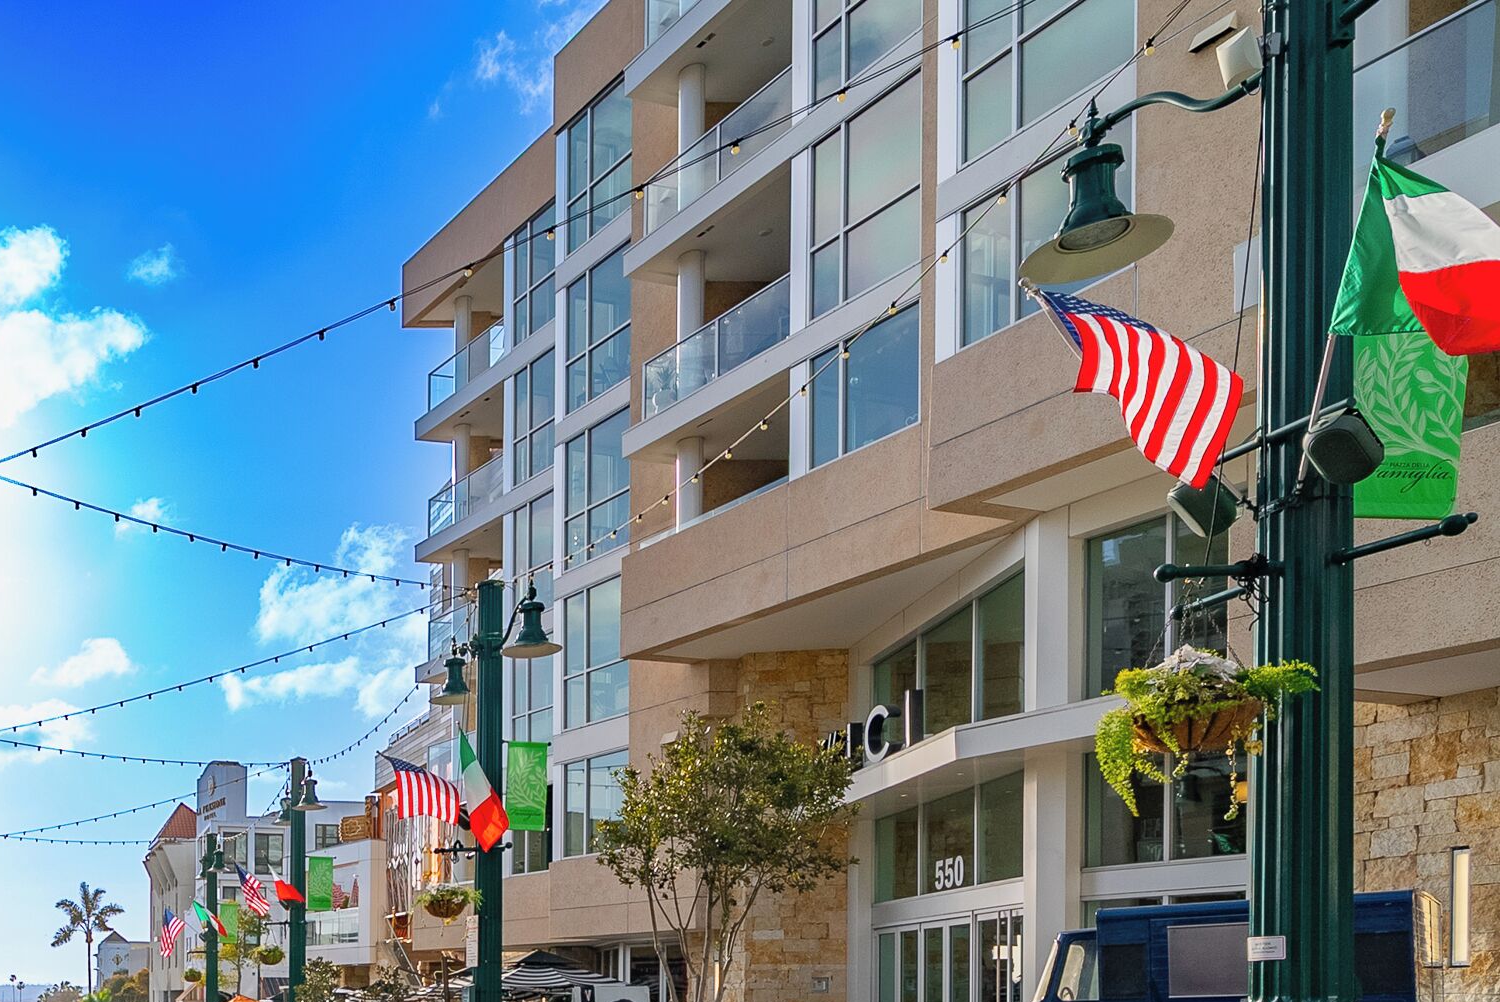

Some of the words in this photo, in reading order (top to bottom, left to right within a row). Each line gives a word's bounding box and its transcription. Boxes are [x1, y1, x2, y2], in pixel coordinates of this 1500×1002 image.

[1375, 459, 1452, 494] amiglia
[935, 855, 964, 890] 550
[585, 989, 592, 1002] V
